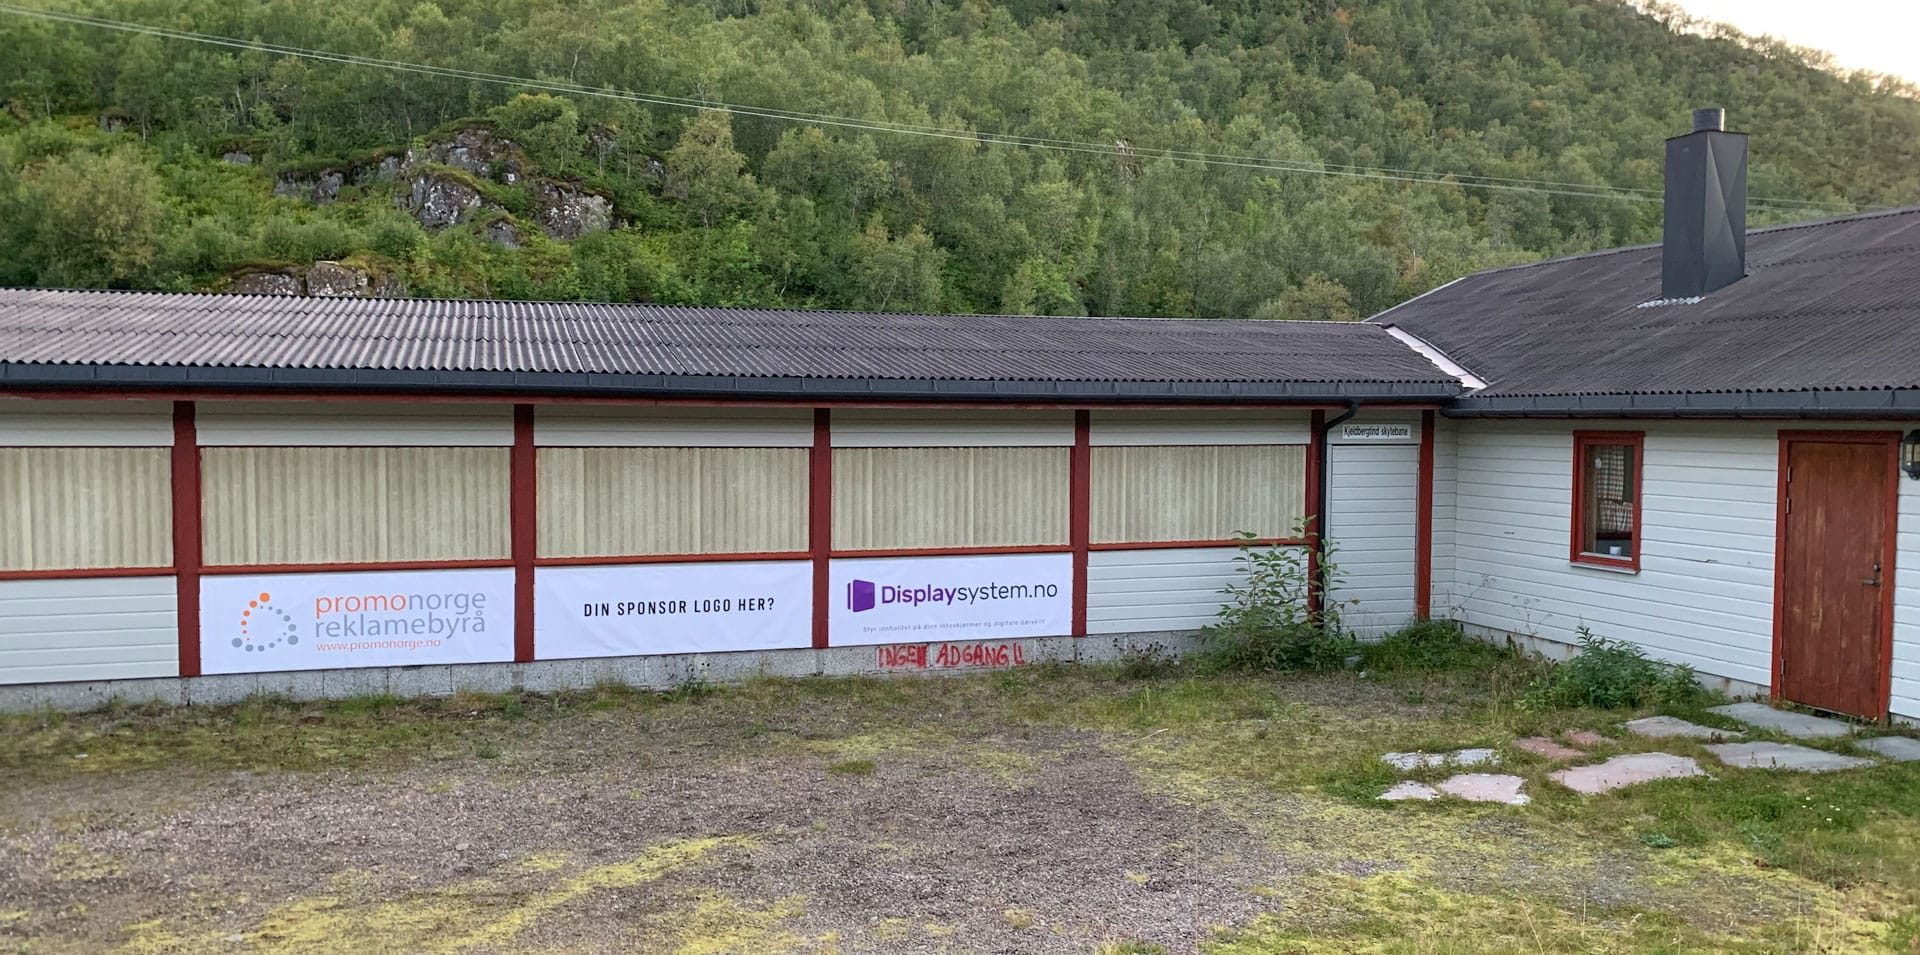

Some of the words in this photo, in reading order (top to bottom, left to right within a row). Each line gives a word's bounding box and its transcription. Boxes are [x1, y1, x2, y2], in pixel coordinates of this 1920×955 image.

[316, 592, 487, 619] promonorge
[882, 582, 1058, 606] Displaysystem.no
[584, 602, 609, 617] DIN
[617, 600, 687, 616] SPONSOR
[694, 599, 731, 613] LOGO
[739, 597, 774, 611] HER?
[315, 611, 486, 639] reklamebyrå
[317, 639, 441, 651] www.promonorge.no
